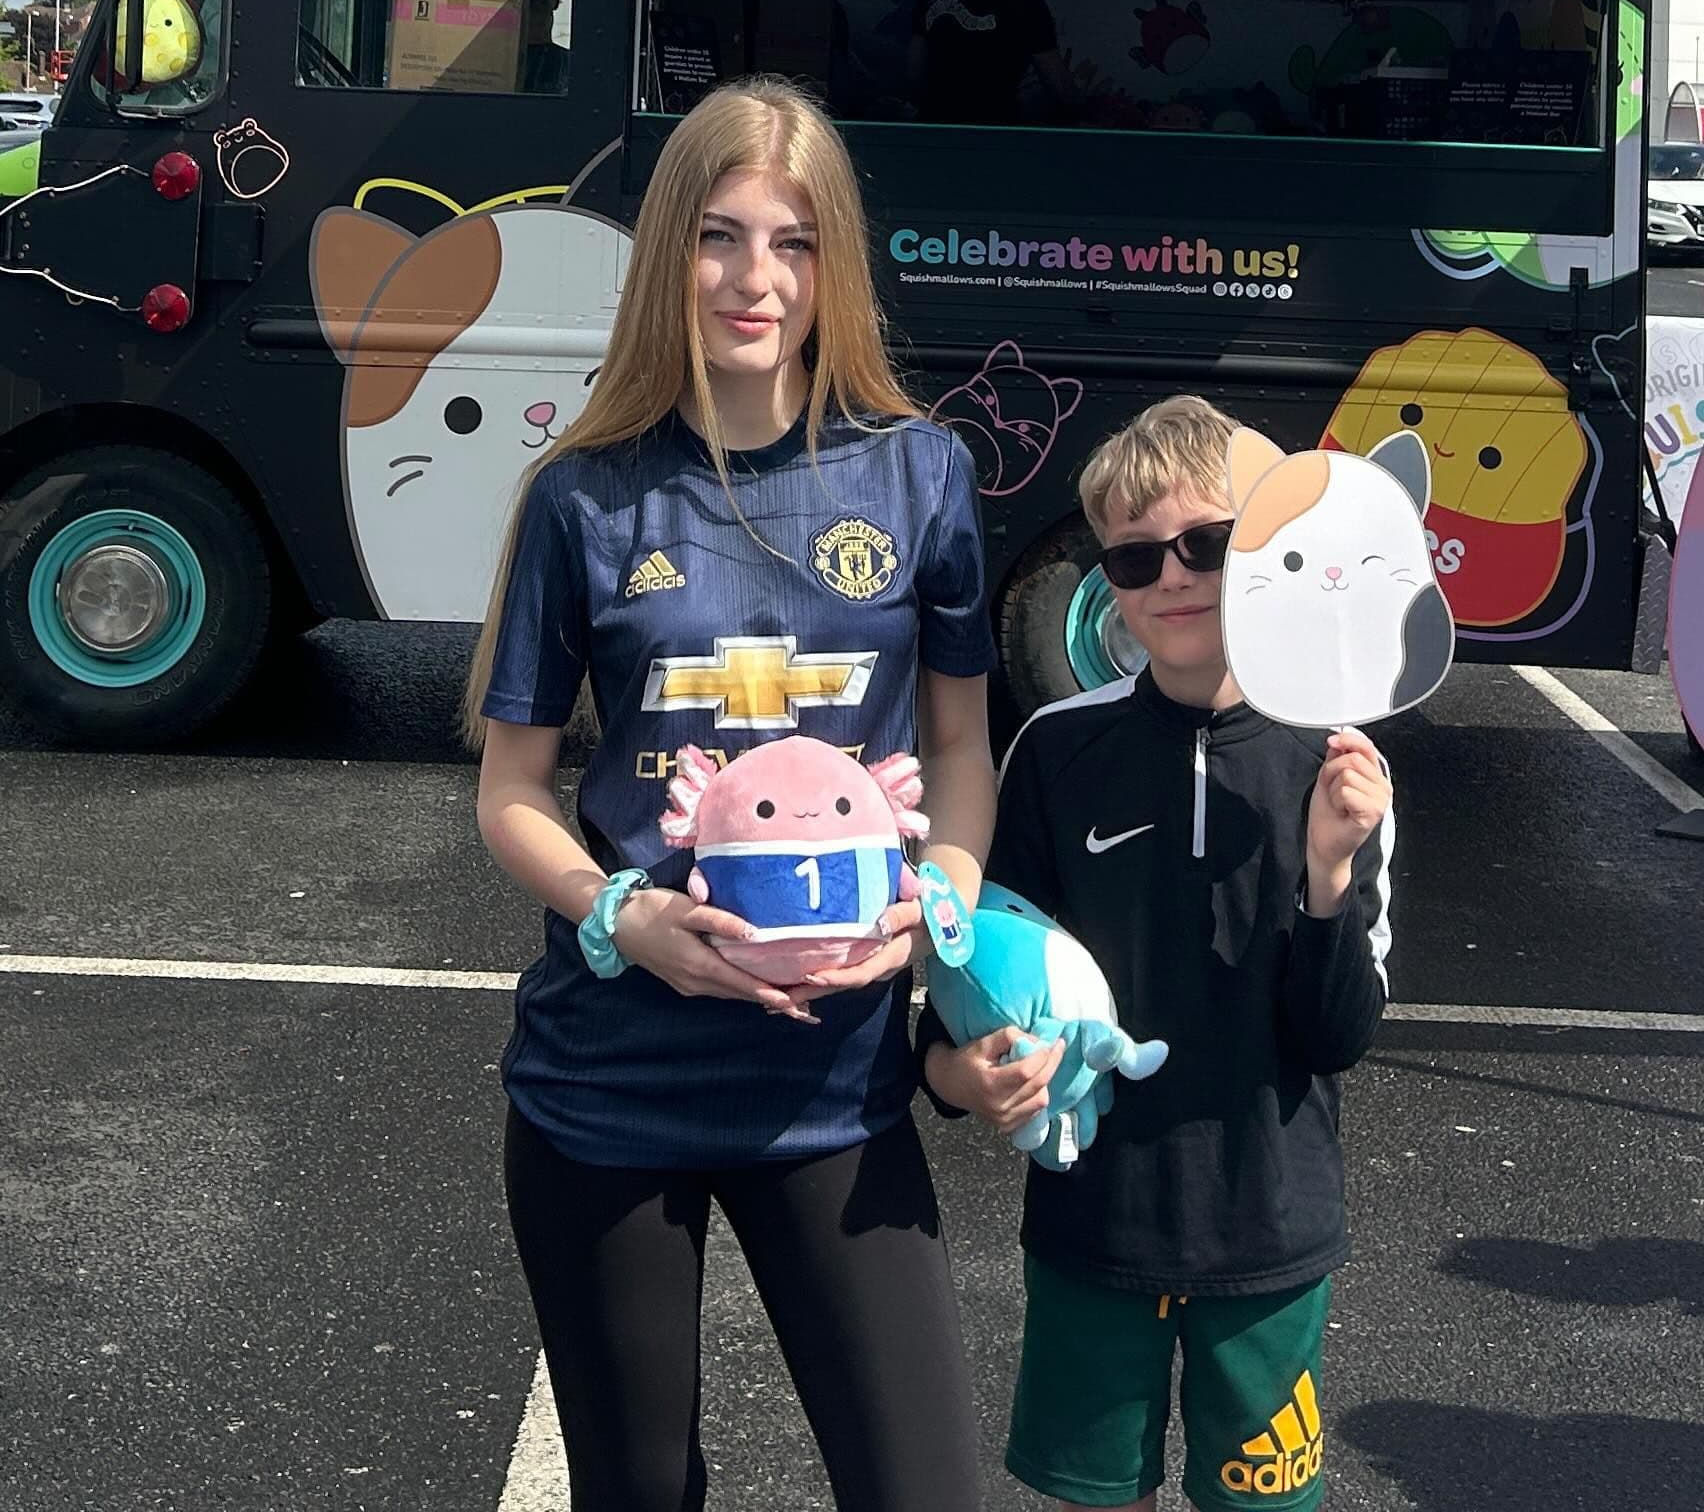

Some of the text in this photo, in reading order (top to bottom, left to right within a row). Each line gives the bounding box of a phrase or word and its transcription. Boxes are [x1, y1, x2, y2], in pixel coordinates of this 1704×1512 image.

[889, 229, 1299, 279] Celebrate with us!
[899, 272, 996, 286] Squishmallows.com
[1003, 276, 1087, 289] @Squishmallows
[1096, 279, 1207, 294] #SquishmallowsSquad
[819, 524, 888, 551] MANCHESTER
[625, 574, 686, 599] adidas
[837, 578, 882, 595] UNITED
[795, 857, 820, 910] 1
[1221, 1432, 1324, 1494] adida
